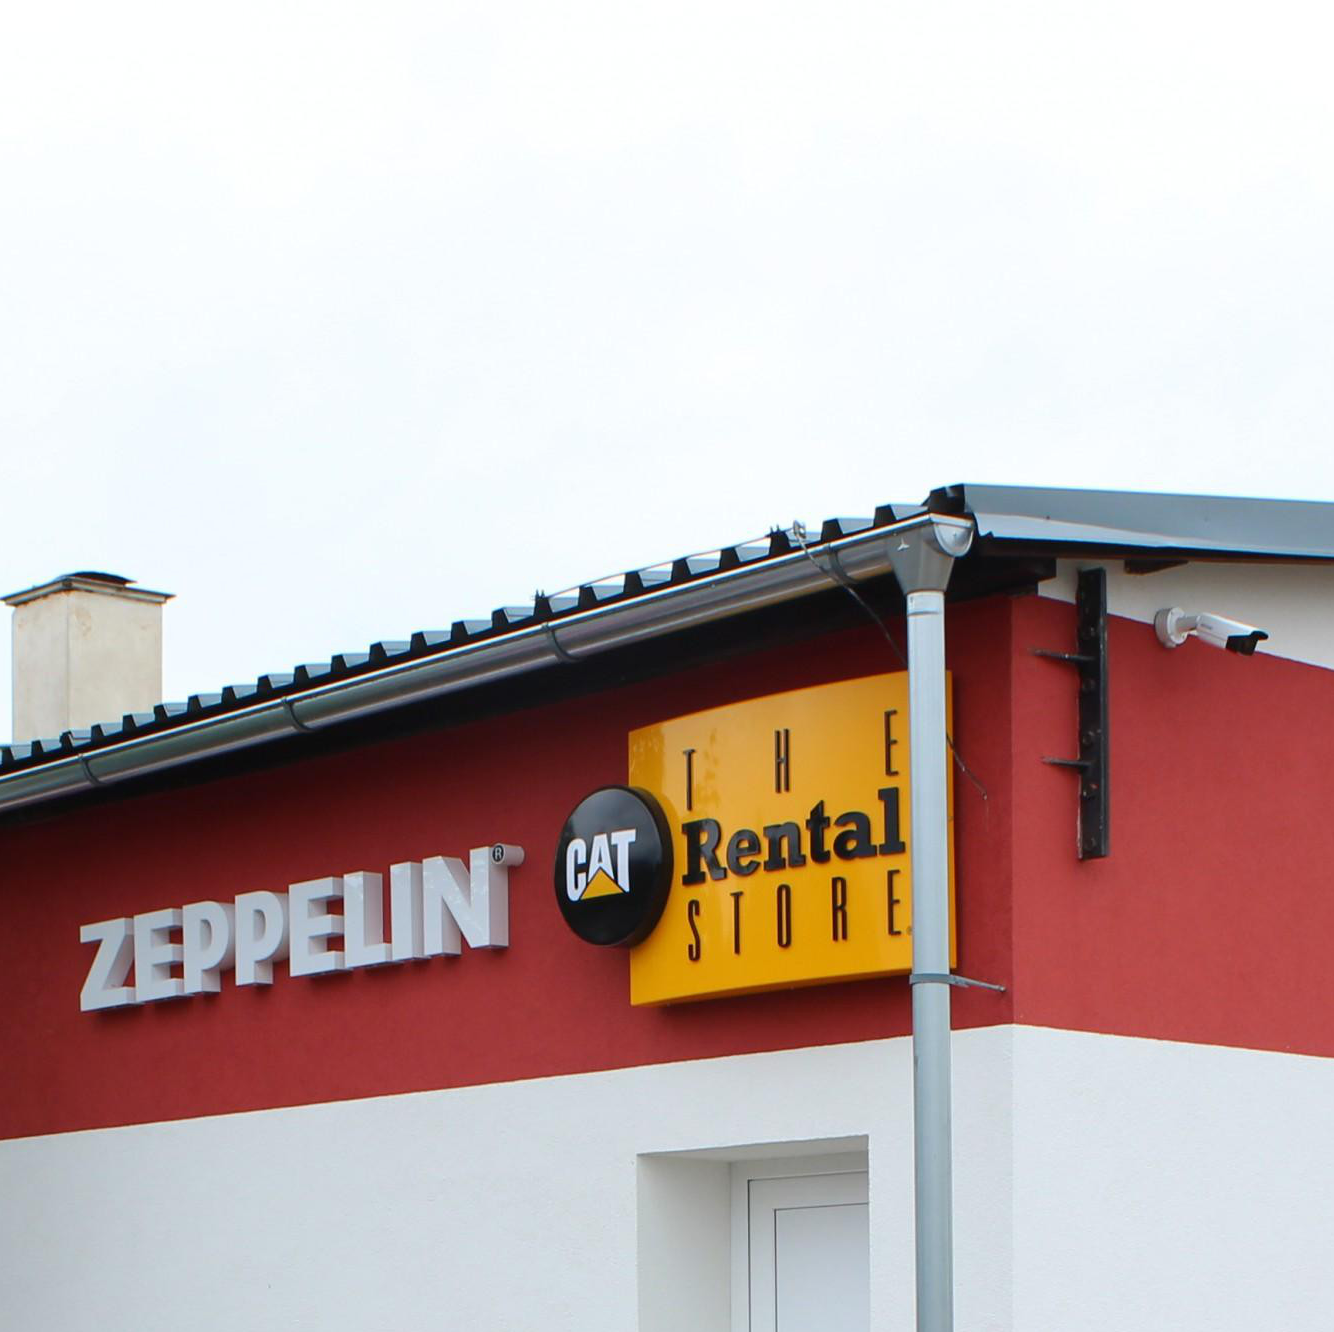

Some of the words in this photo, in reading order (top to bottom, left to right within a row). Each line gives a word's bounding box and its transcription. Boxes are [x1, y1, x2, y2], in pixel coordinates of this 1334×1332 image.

[682, 709, 899, 811] THE
[566, 829, 636, 901] CAT
[681, 787, 906, 886] Rental
[687, 869, 901, 961] STORE
